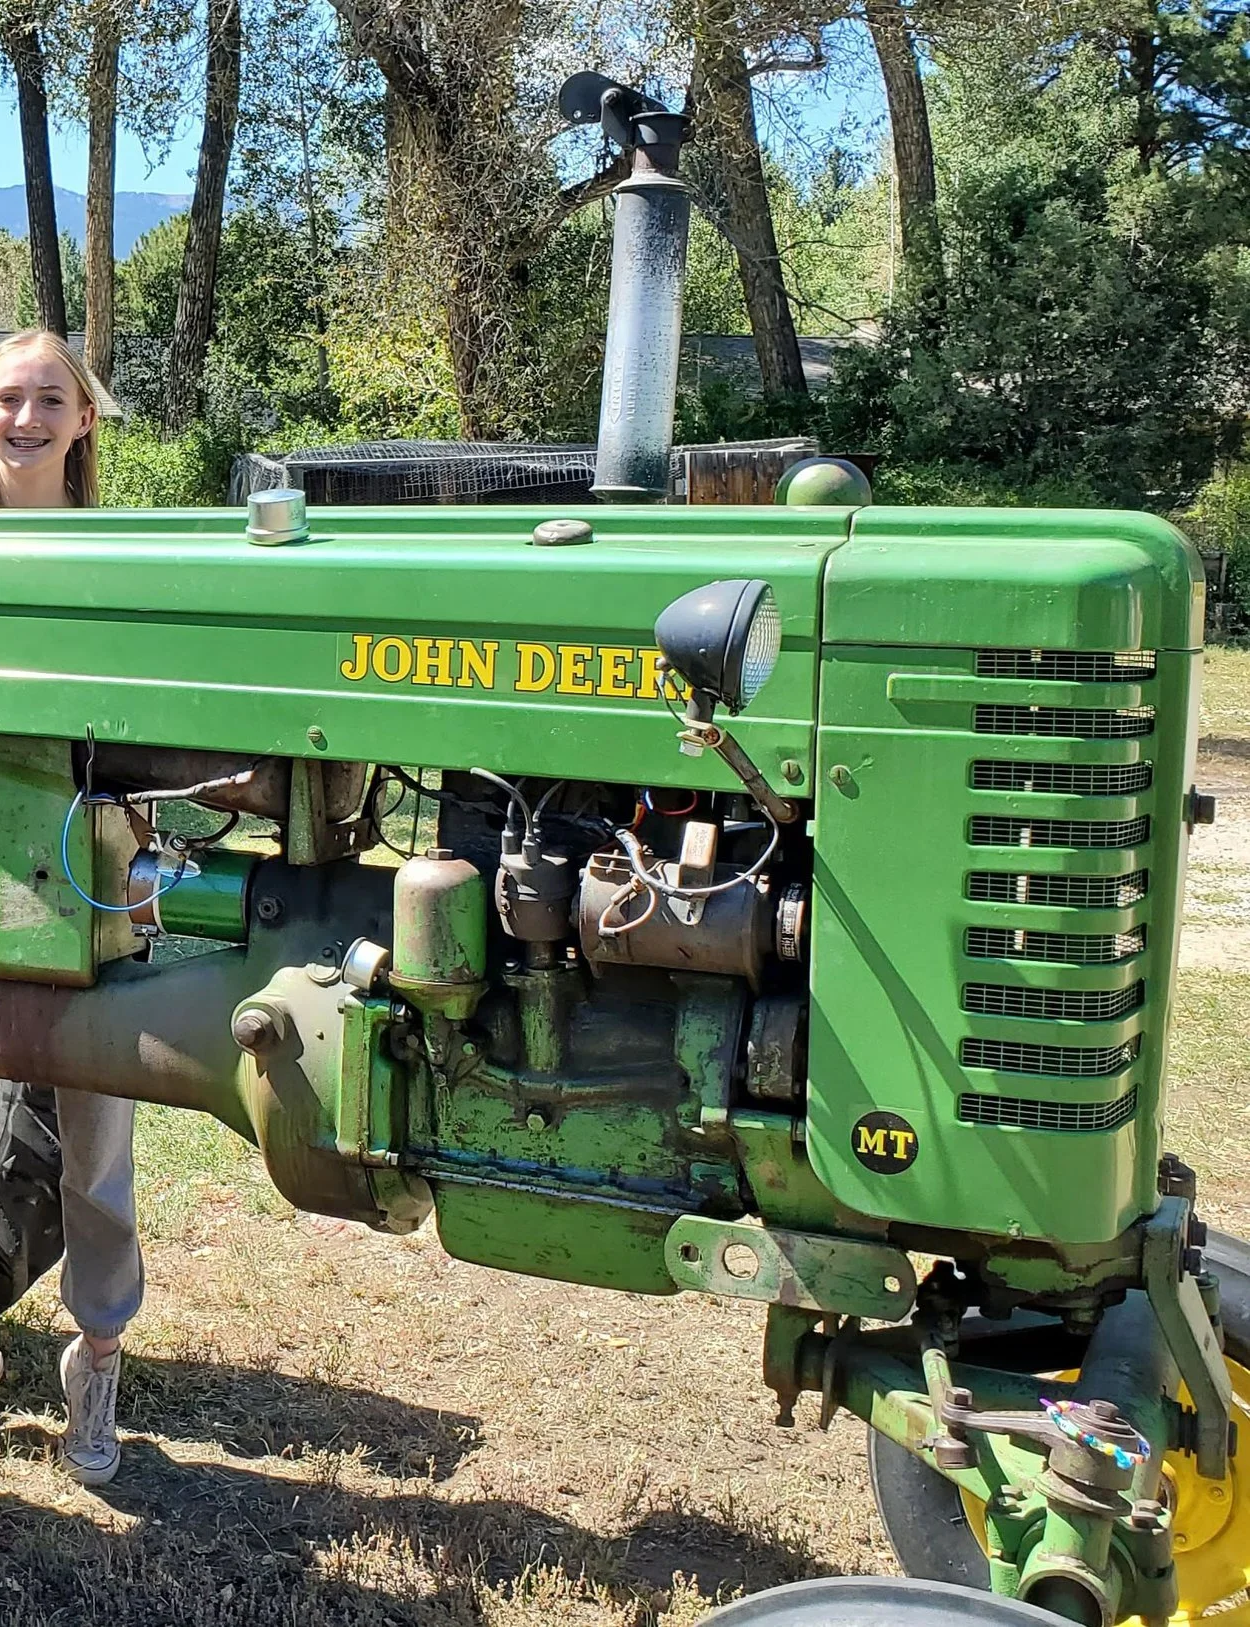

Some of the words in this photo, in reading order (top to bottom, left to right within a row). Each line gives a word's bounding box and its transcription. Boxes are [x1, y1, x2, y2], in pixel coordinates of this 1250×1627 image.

[340, 634, 499, 690] JOHN
[514, 641, 694, 701] DEER
[857, 1126, 914, 1160] MT
